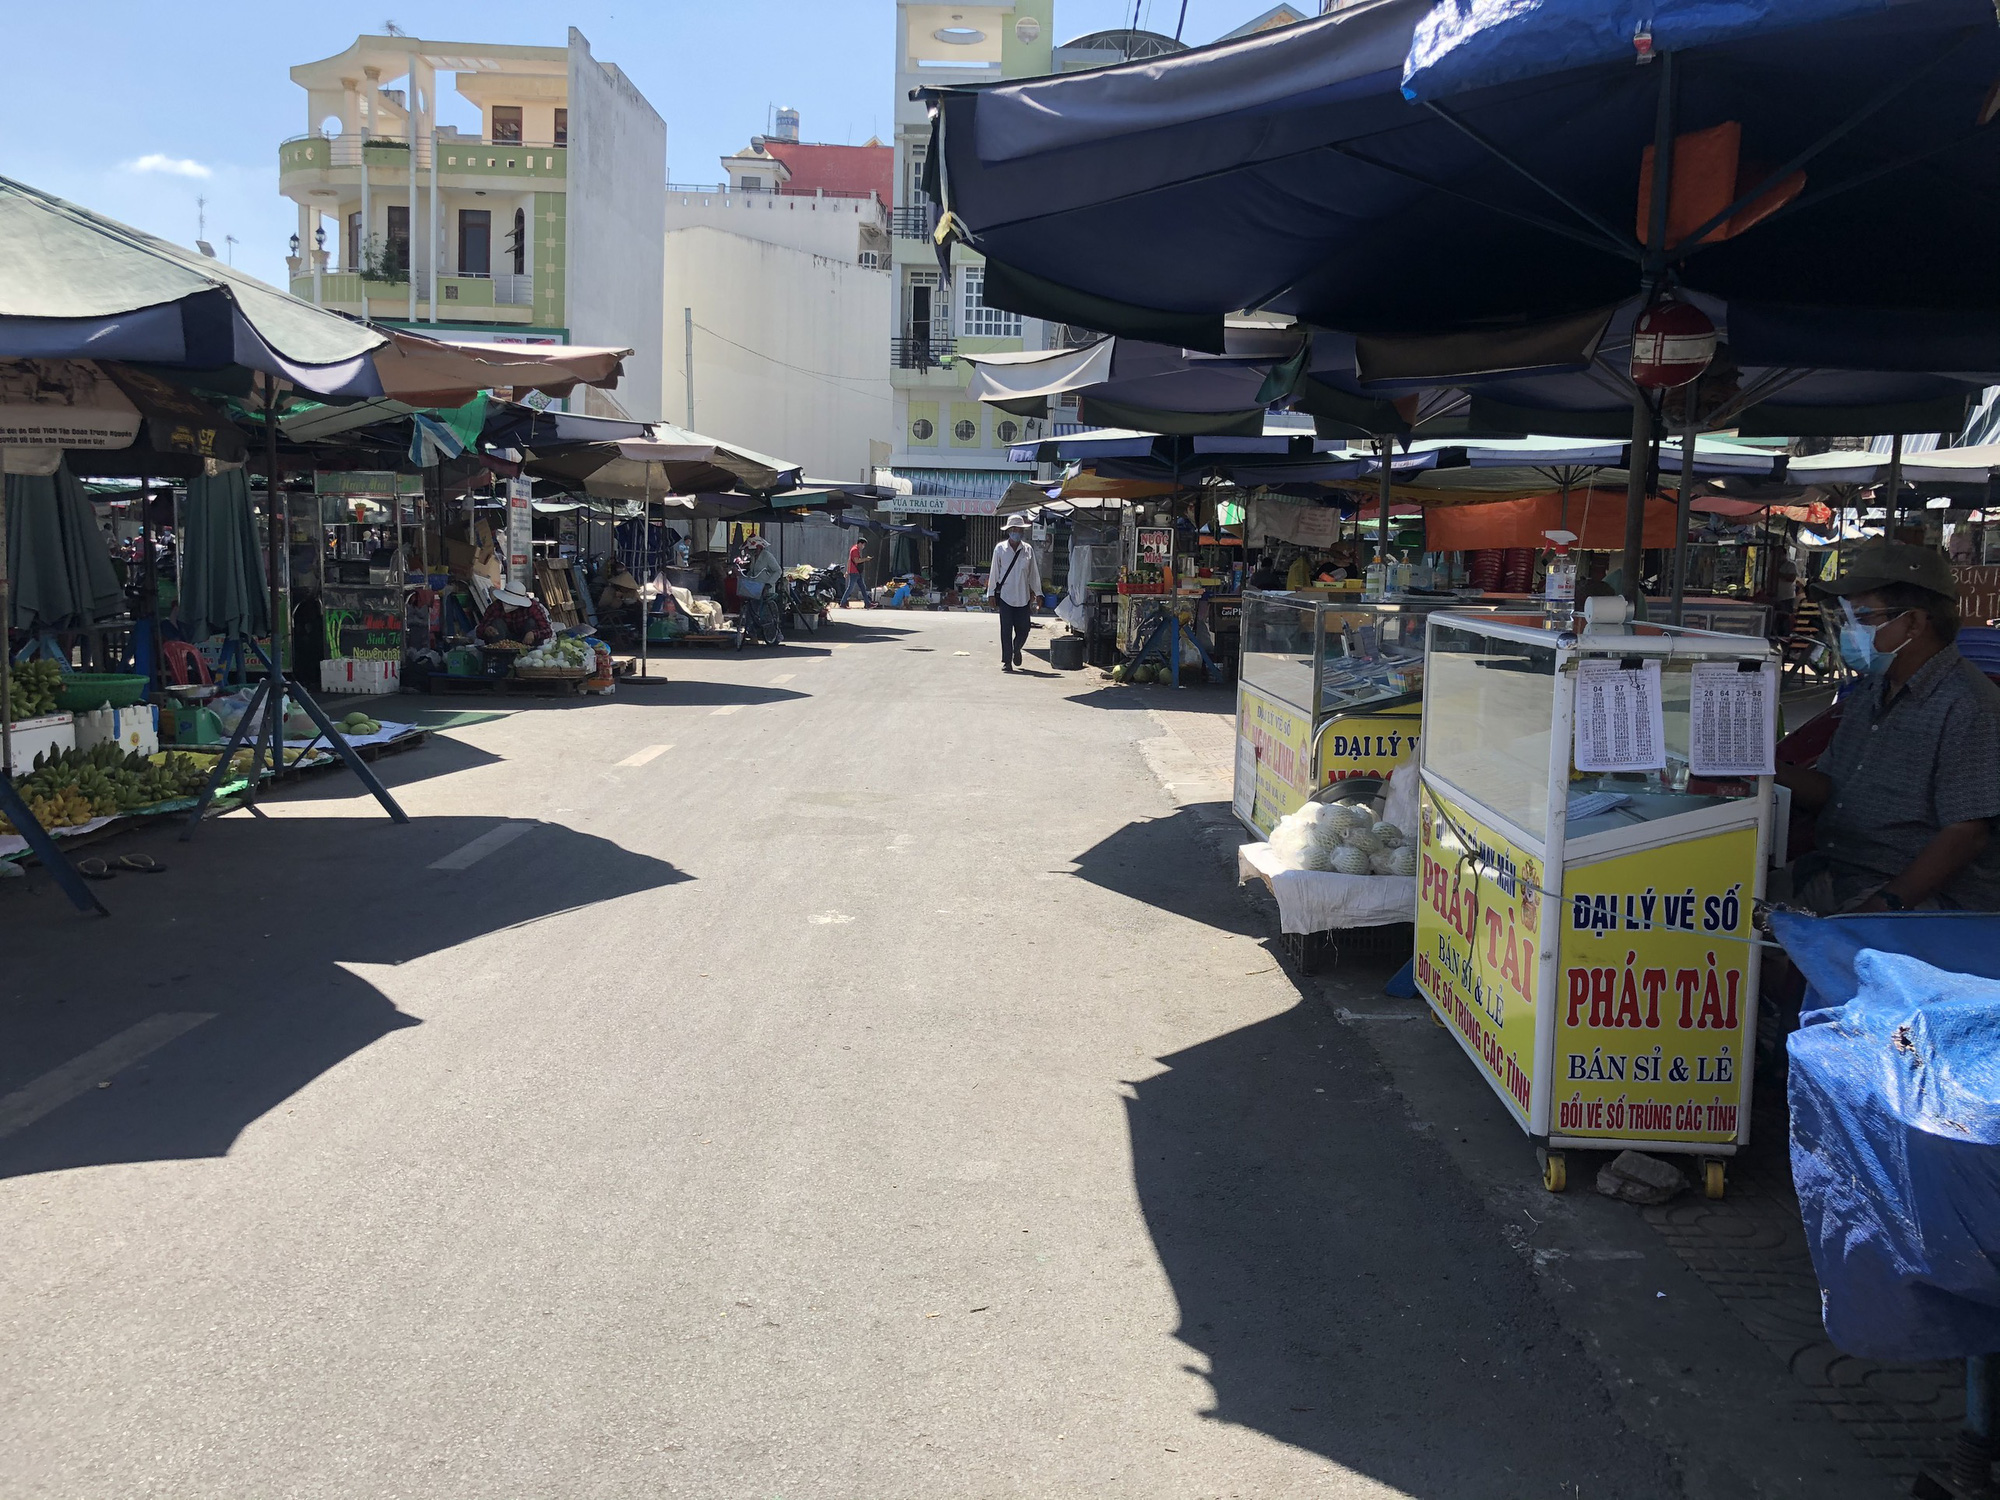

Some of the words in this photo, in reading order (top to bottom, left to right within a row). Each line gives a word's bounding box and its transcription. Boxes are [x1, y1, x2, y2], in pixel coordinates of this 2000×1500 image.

[909, 498, 927, 507] TRÁI
[929, 499, 945, 508] CÂY
[946, 499, 999, 515] NHO
[1334, 735, 1371, 761] ĐẠI
[1376, 730, 1402, 757] LÝ
[1479, 840, 1496, 882] MAY
[1497, 847, 1517, 899] MẮN
[1421, 853, 1479, 945] PHÁT
[1486, 906, 1535, 1004] TÀI
[1573, 894, 1619, 938] ĐẠI
[1626, 887, 1657, 930] LÝ
[1664, 888, 1696, 930] VÉ
[1703, 883, 1742, 931] SỐ
[1438, 933, 1461, 980] BÁN
[1474, 975, 1484, 1007] &
[1486, 983, 1505, 1029] LẺ
[1566, 950, 1667, 1029] PHÁT
[1675, 951, 1741, 1030] TÀI
[1418, 950, 1431, 989] ĐỔI
[1432, 968, 1442, 1001] VÉ
[1442, 979, 1453, 1015] SỐ
[1454, 995, 1481, 1053] TRÚNG
[1483, 1031, 1504, 1079] CÁC
[1506, 1051, 1532, 1114] TỈNH
[1567, 1046, 1627, 1081] BÁN
[1633, 1045, 1662, 1082] SỈ
[1668, 1056, 1690, 1082] &
[1696, 1045, 1733, 1083] LẺ
[1560, 1091, 1584, 1129] ĐỔI
[1587, 1097, 1604, 1130] VÉ
[1606, 1093, 1625, 1130] SỐ
[1628, 1098, 1673, 1131] TRÚNG
[1675, 1099, 1704, 1132] CÁC
[1706, 1096, 1738, 1133] TỈNH
